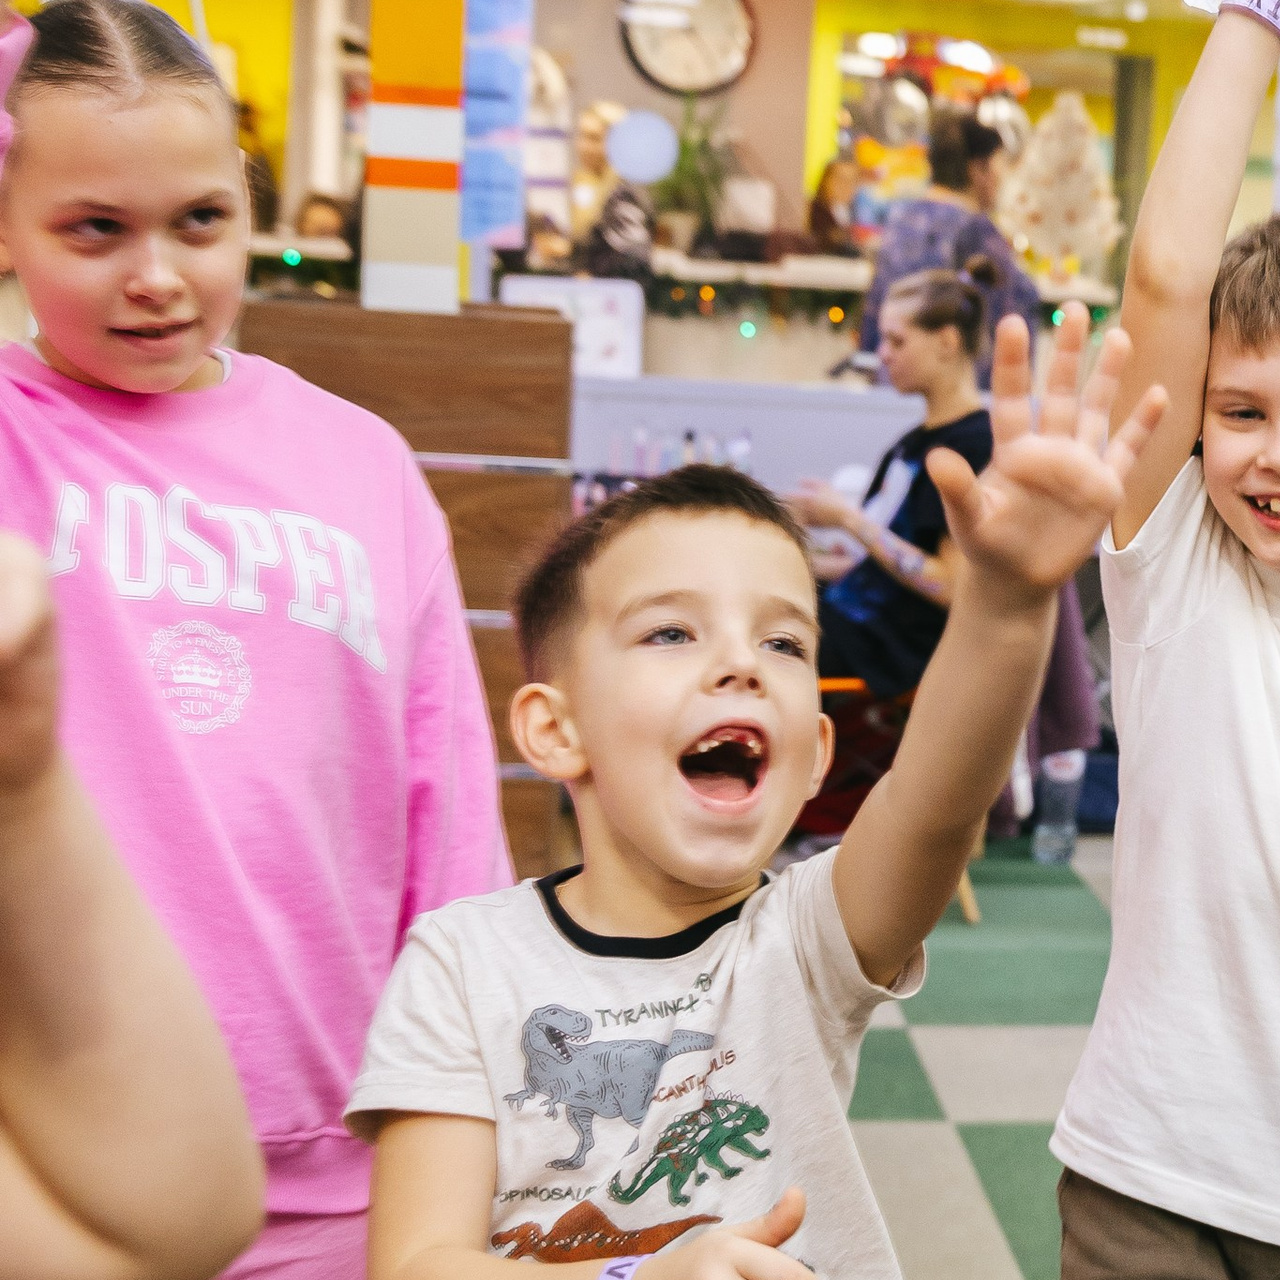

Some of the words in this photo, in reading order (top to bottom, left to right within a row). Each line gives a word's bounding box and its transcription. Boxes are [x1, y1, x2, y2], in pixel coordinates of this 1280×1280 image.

[185, 637, 193, 646] A
[162, 686, 203, 699] UNDER
[207, 688, 229, 704] THE
[180, 700, 213, 715] SUN
